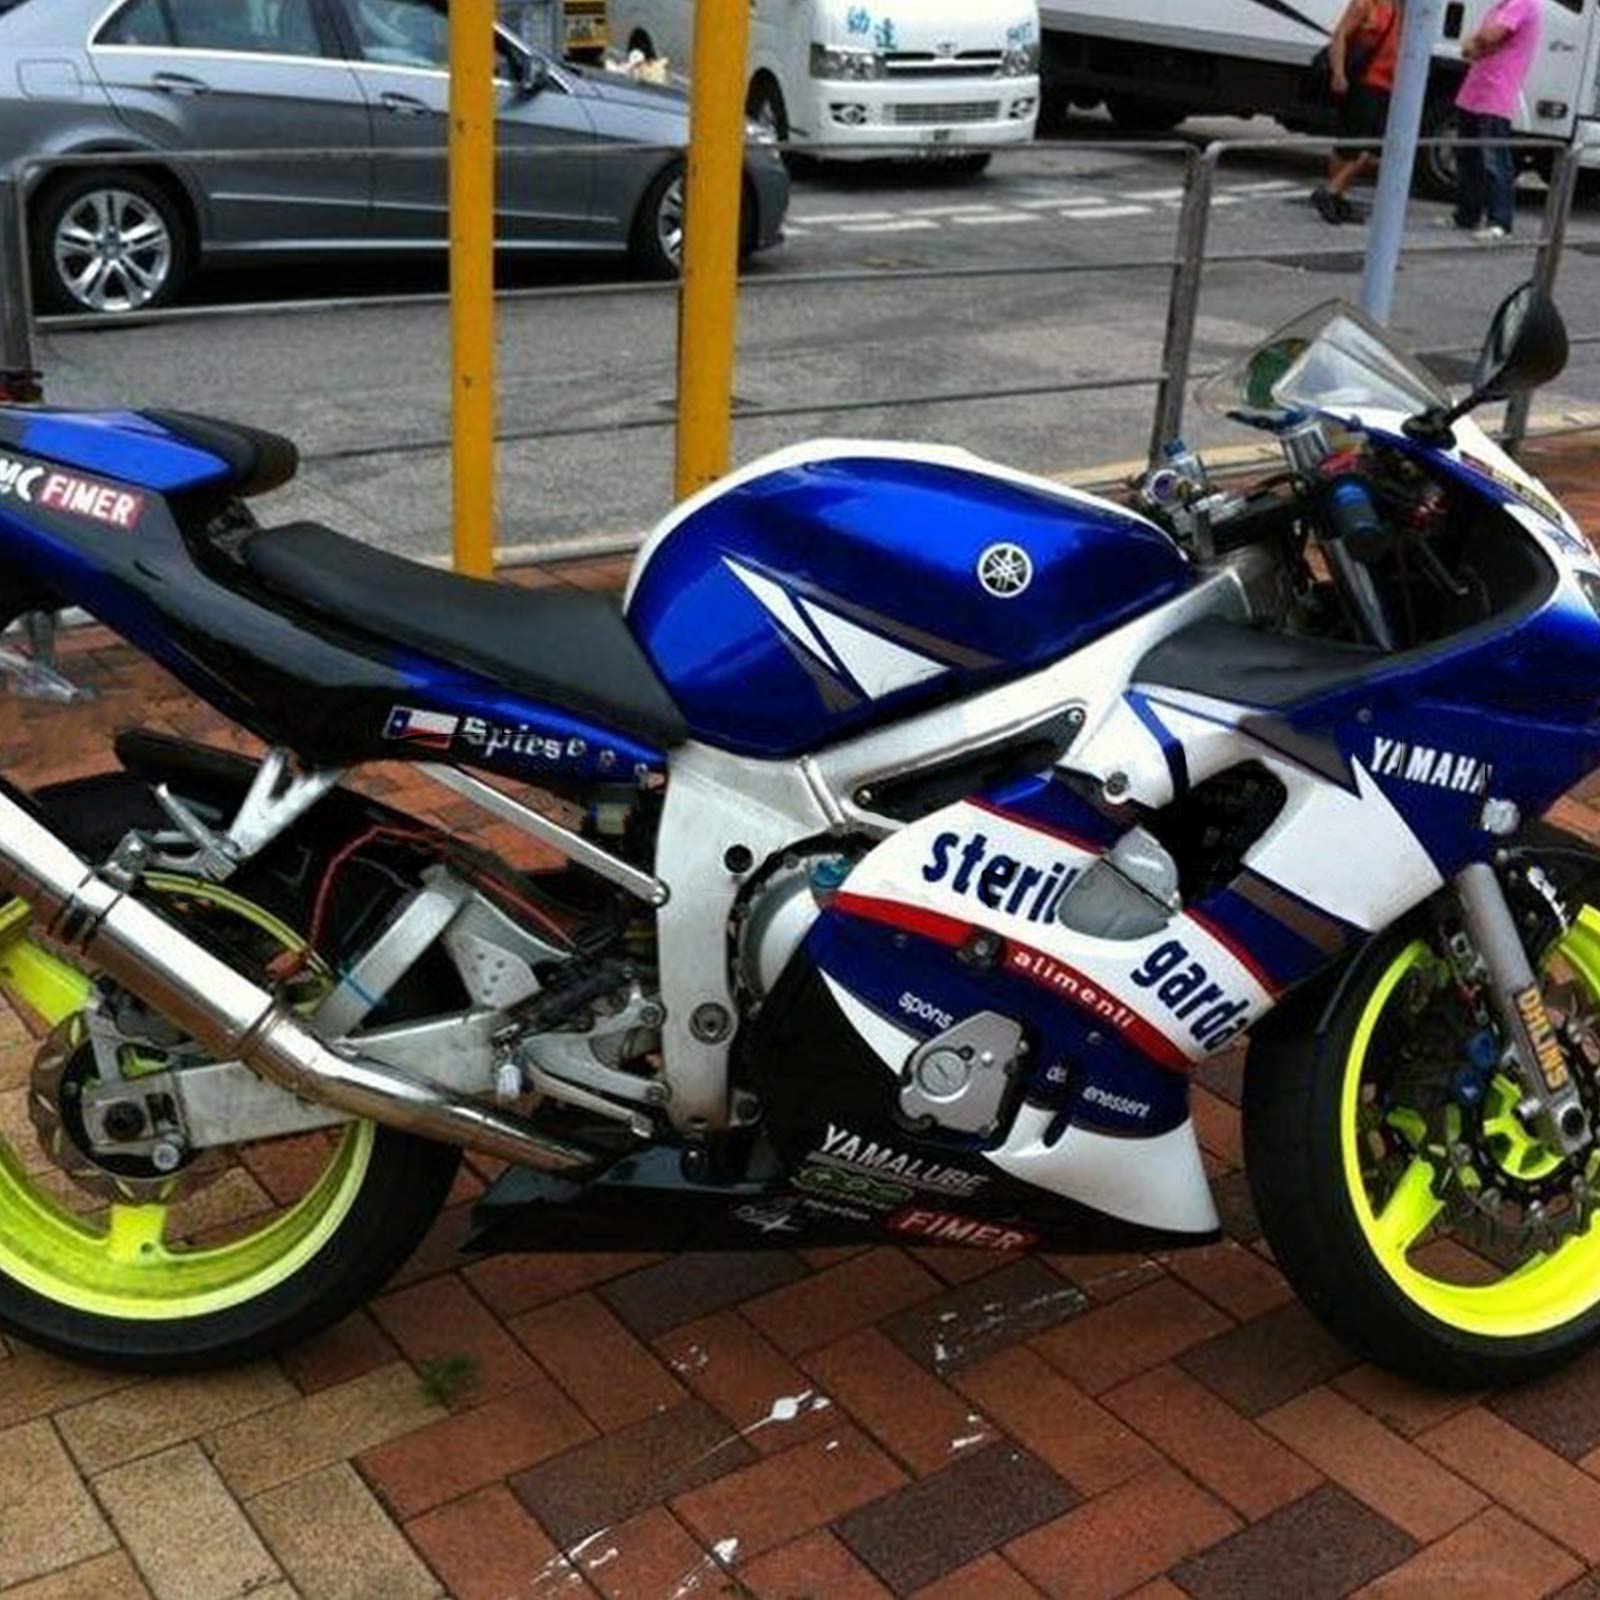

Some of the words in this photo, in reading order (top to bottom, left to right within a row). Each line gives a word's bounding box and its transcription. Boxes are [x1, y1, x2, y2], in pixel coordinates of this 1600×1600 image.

[41, 472, 136, 525] FIMER
[464, 716, 561, 759] Spies
[1370, 736, 1493, 796] YAMAHA
[1014, 950, 1133, 1028] alimenti
[820, 1123, 990, 1191] YAMALUBE
[900, 1210, 1024, 1250] FIMER
